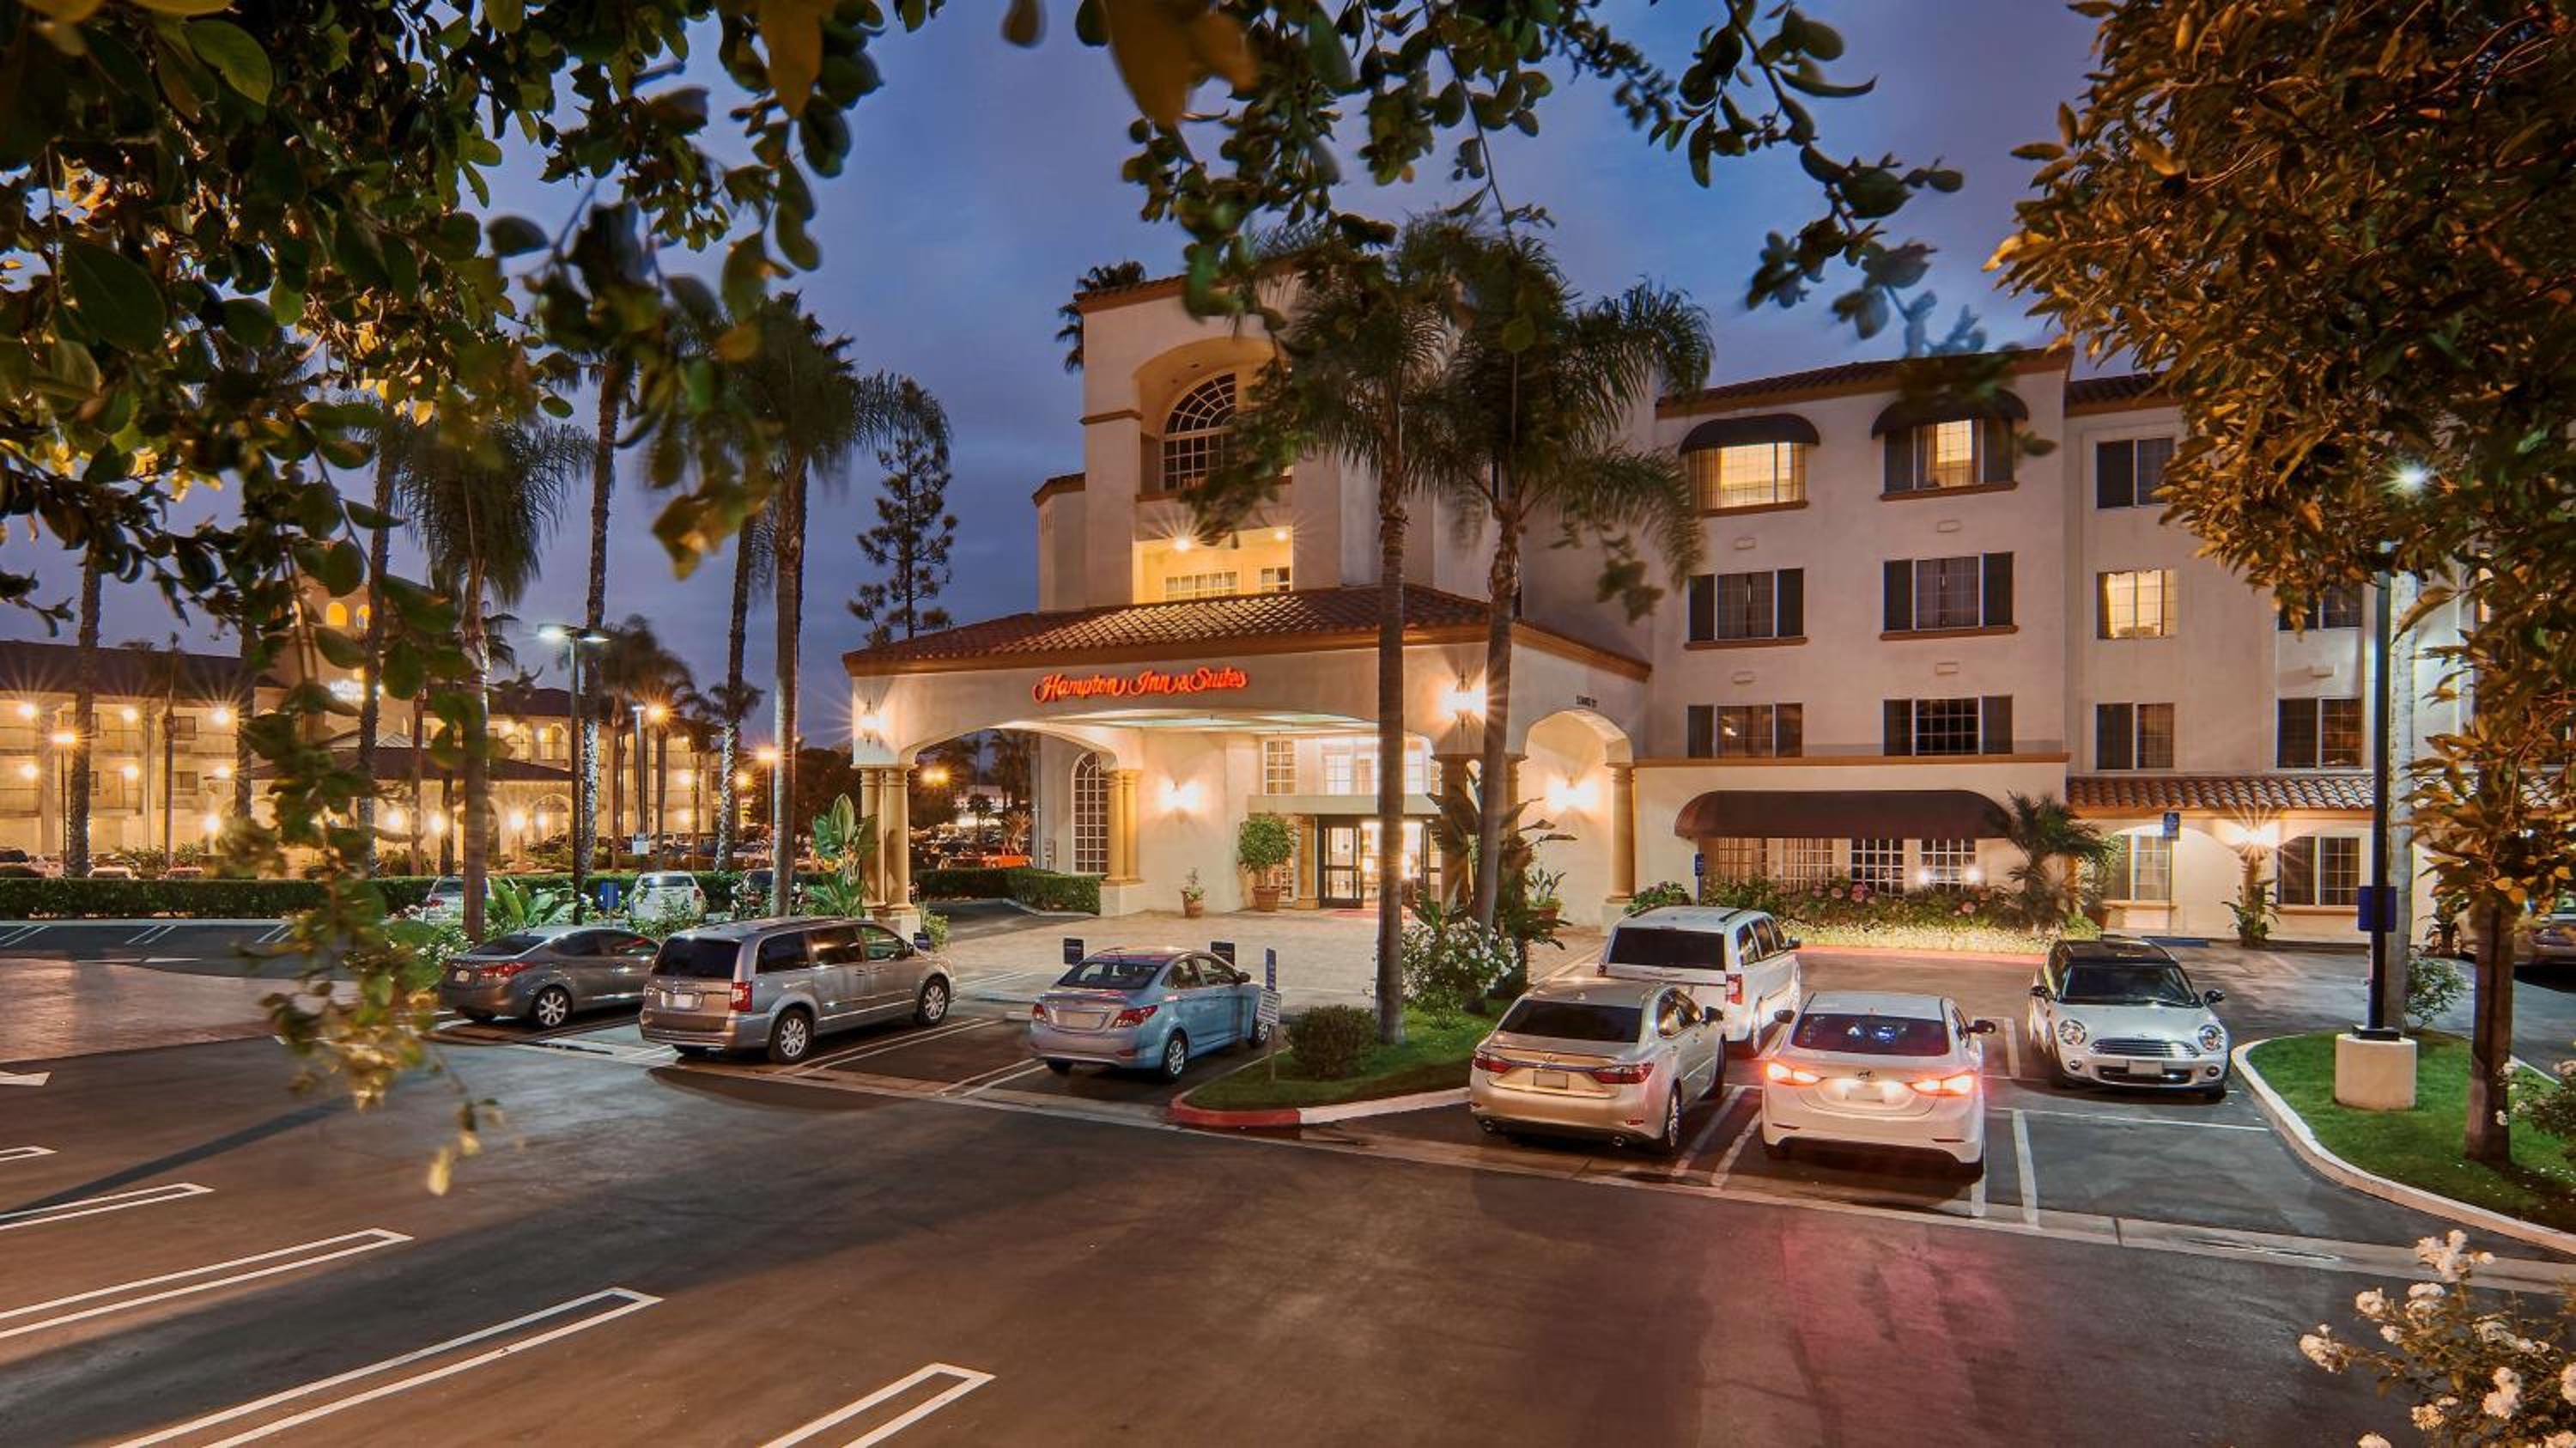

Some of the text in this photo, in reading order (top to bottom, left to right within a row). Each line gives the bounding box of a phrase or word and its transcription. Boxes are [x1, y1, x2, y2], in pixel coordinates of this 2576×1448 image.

[1032, 672, 1127, 703] Hampton
[1128, 669, 1178, 695] Inn
[1190, 666, 1248, 691] Suites
